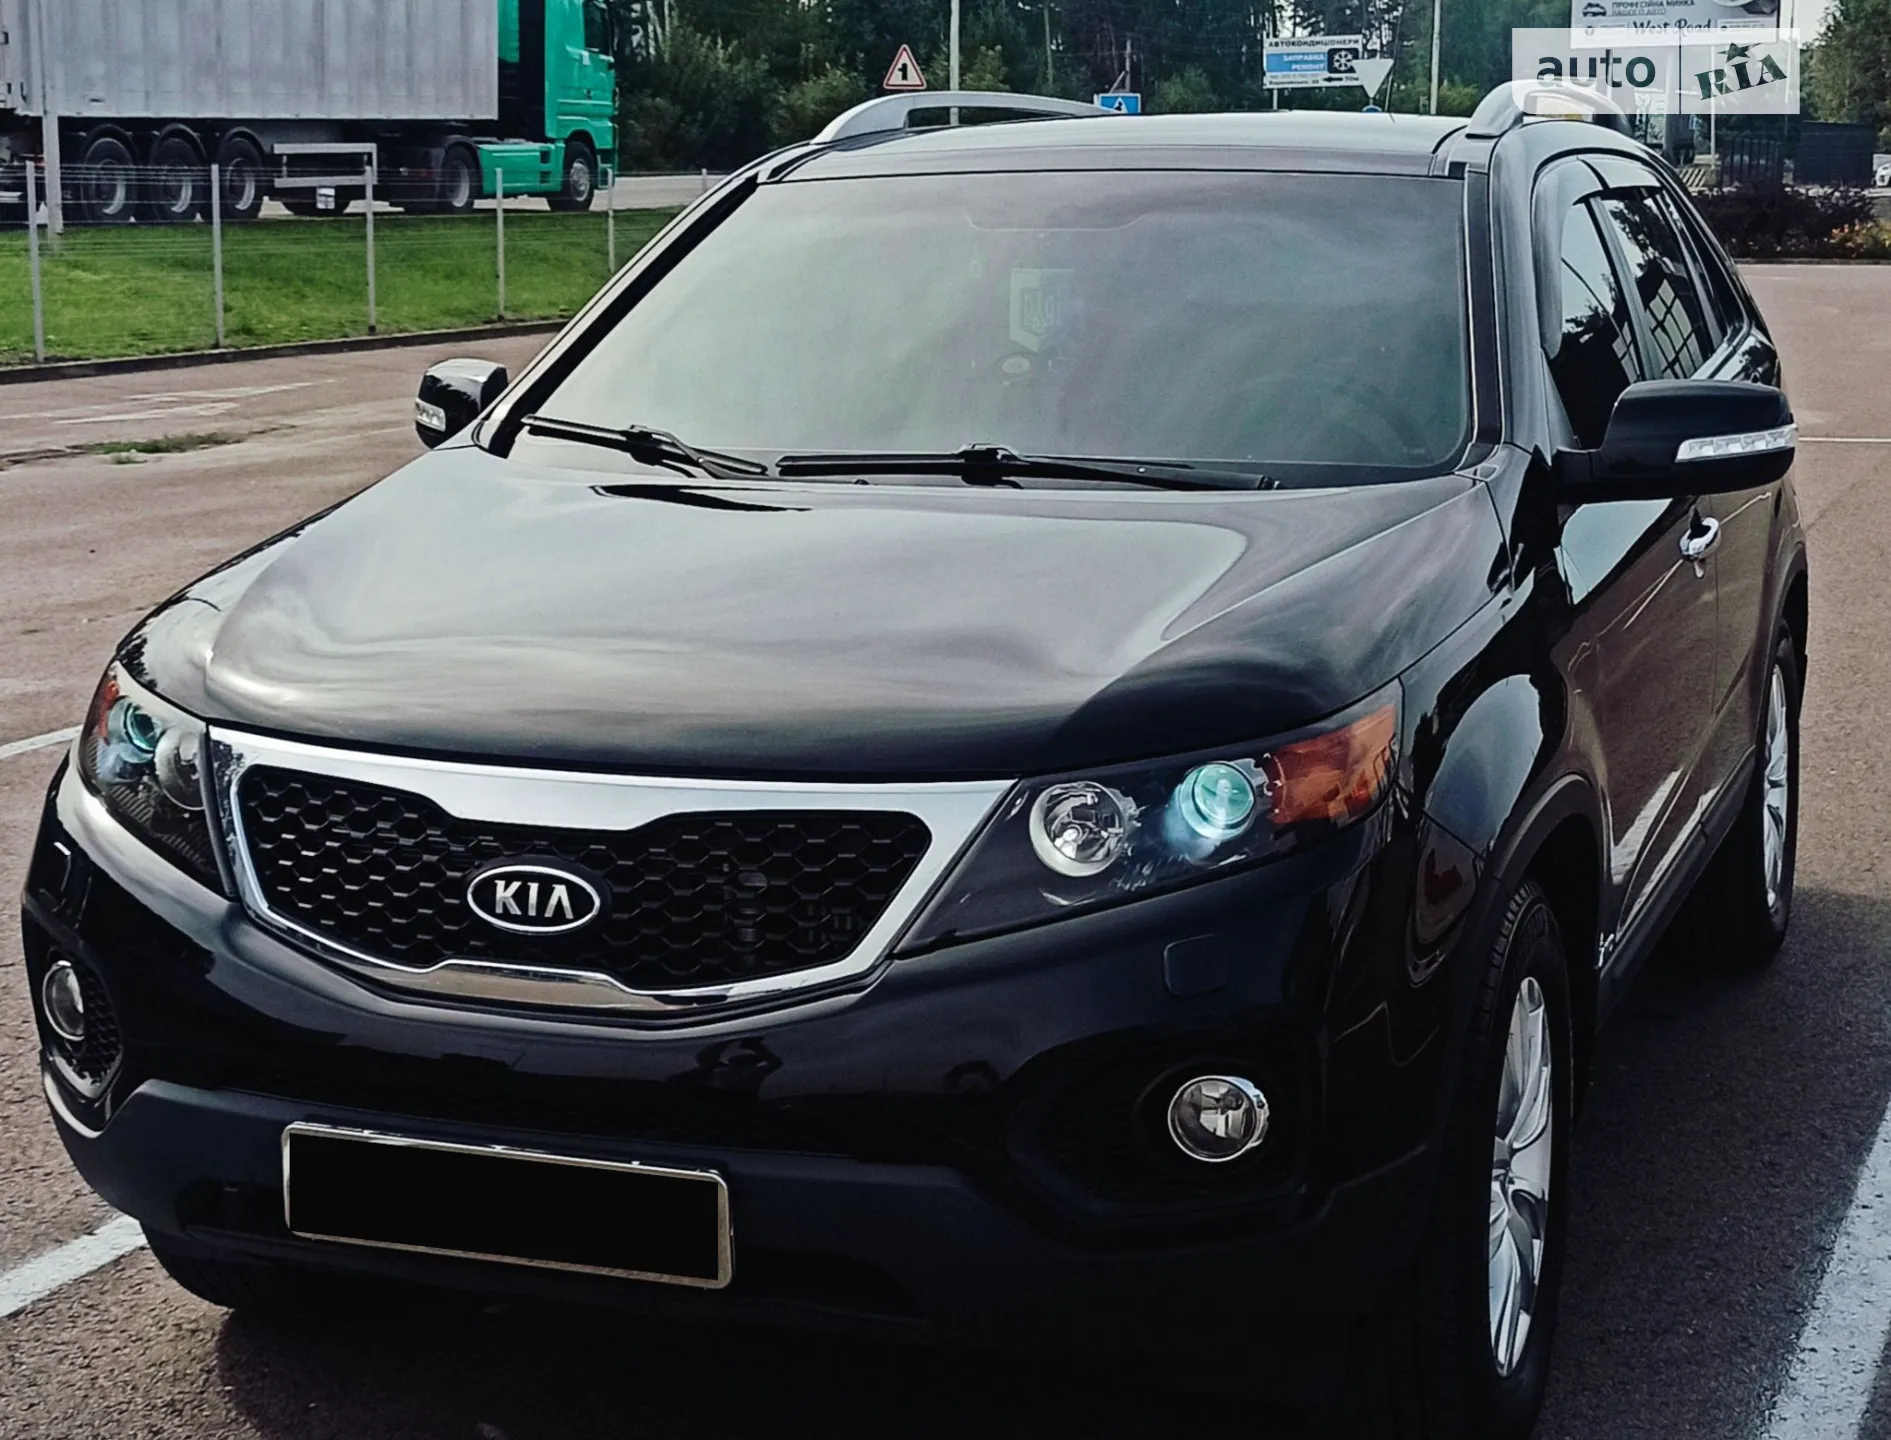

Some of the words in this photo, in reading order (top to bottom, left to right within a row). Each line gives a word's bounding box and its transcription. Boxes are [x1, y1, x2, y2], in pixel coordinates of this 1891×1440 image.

[1632, 20, 1671, 35] West
[1674, 18, 1712, 37] Road
[494, 880, 575, 920] KIA
